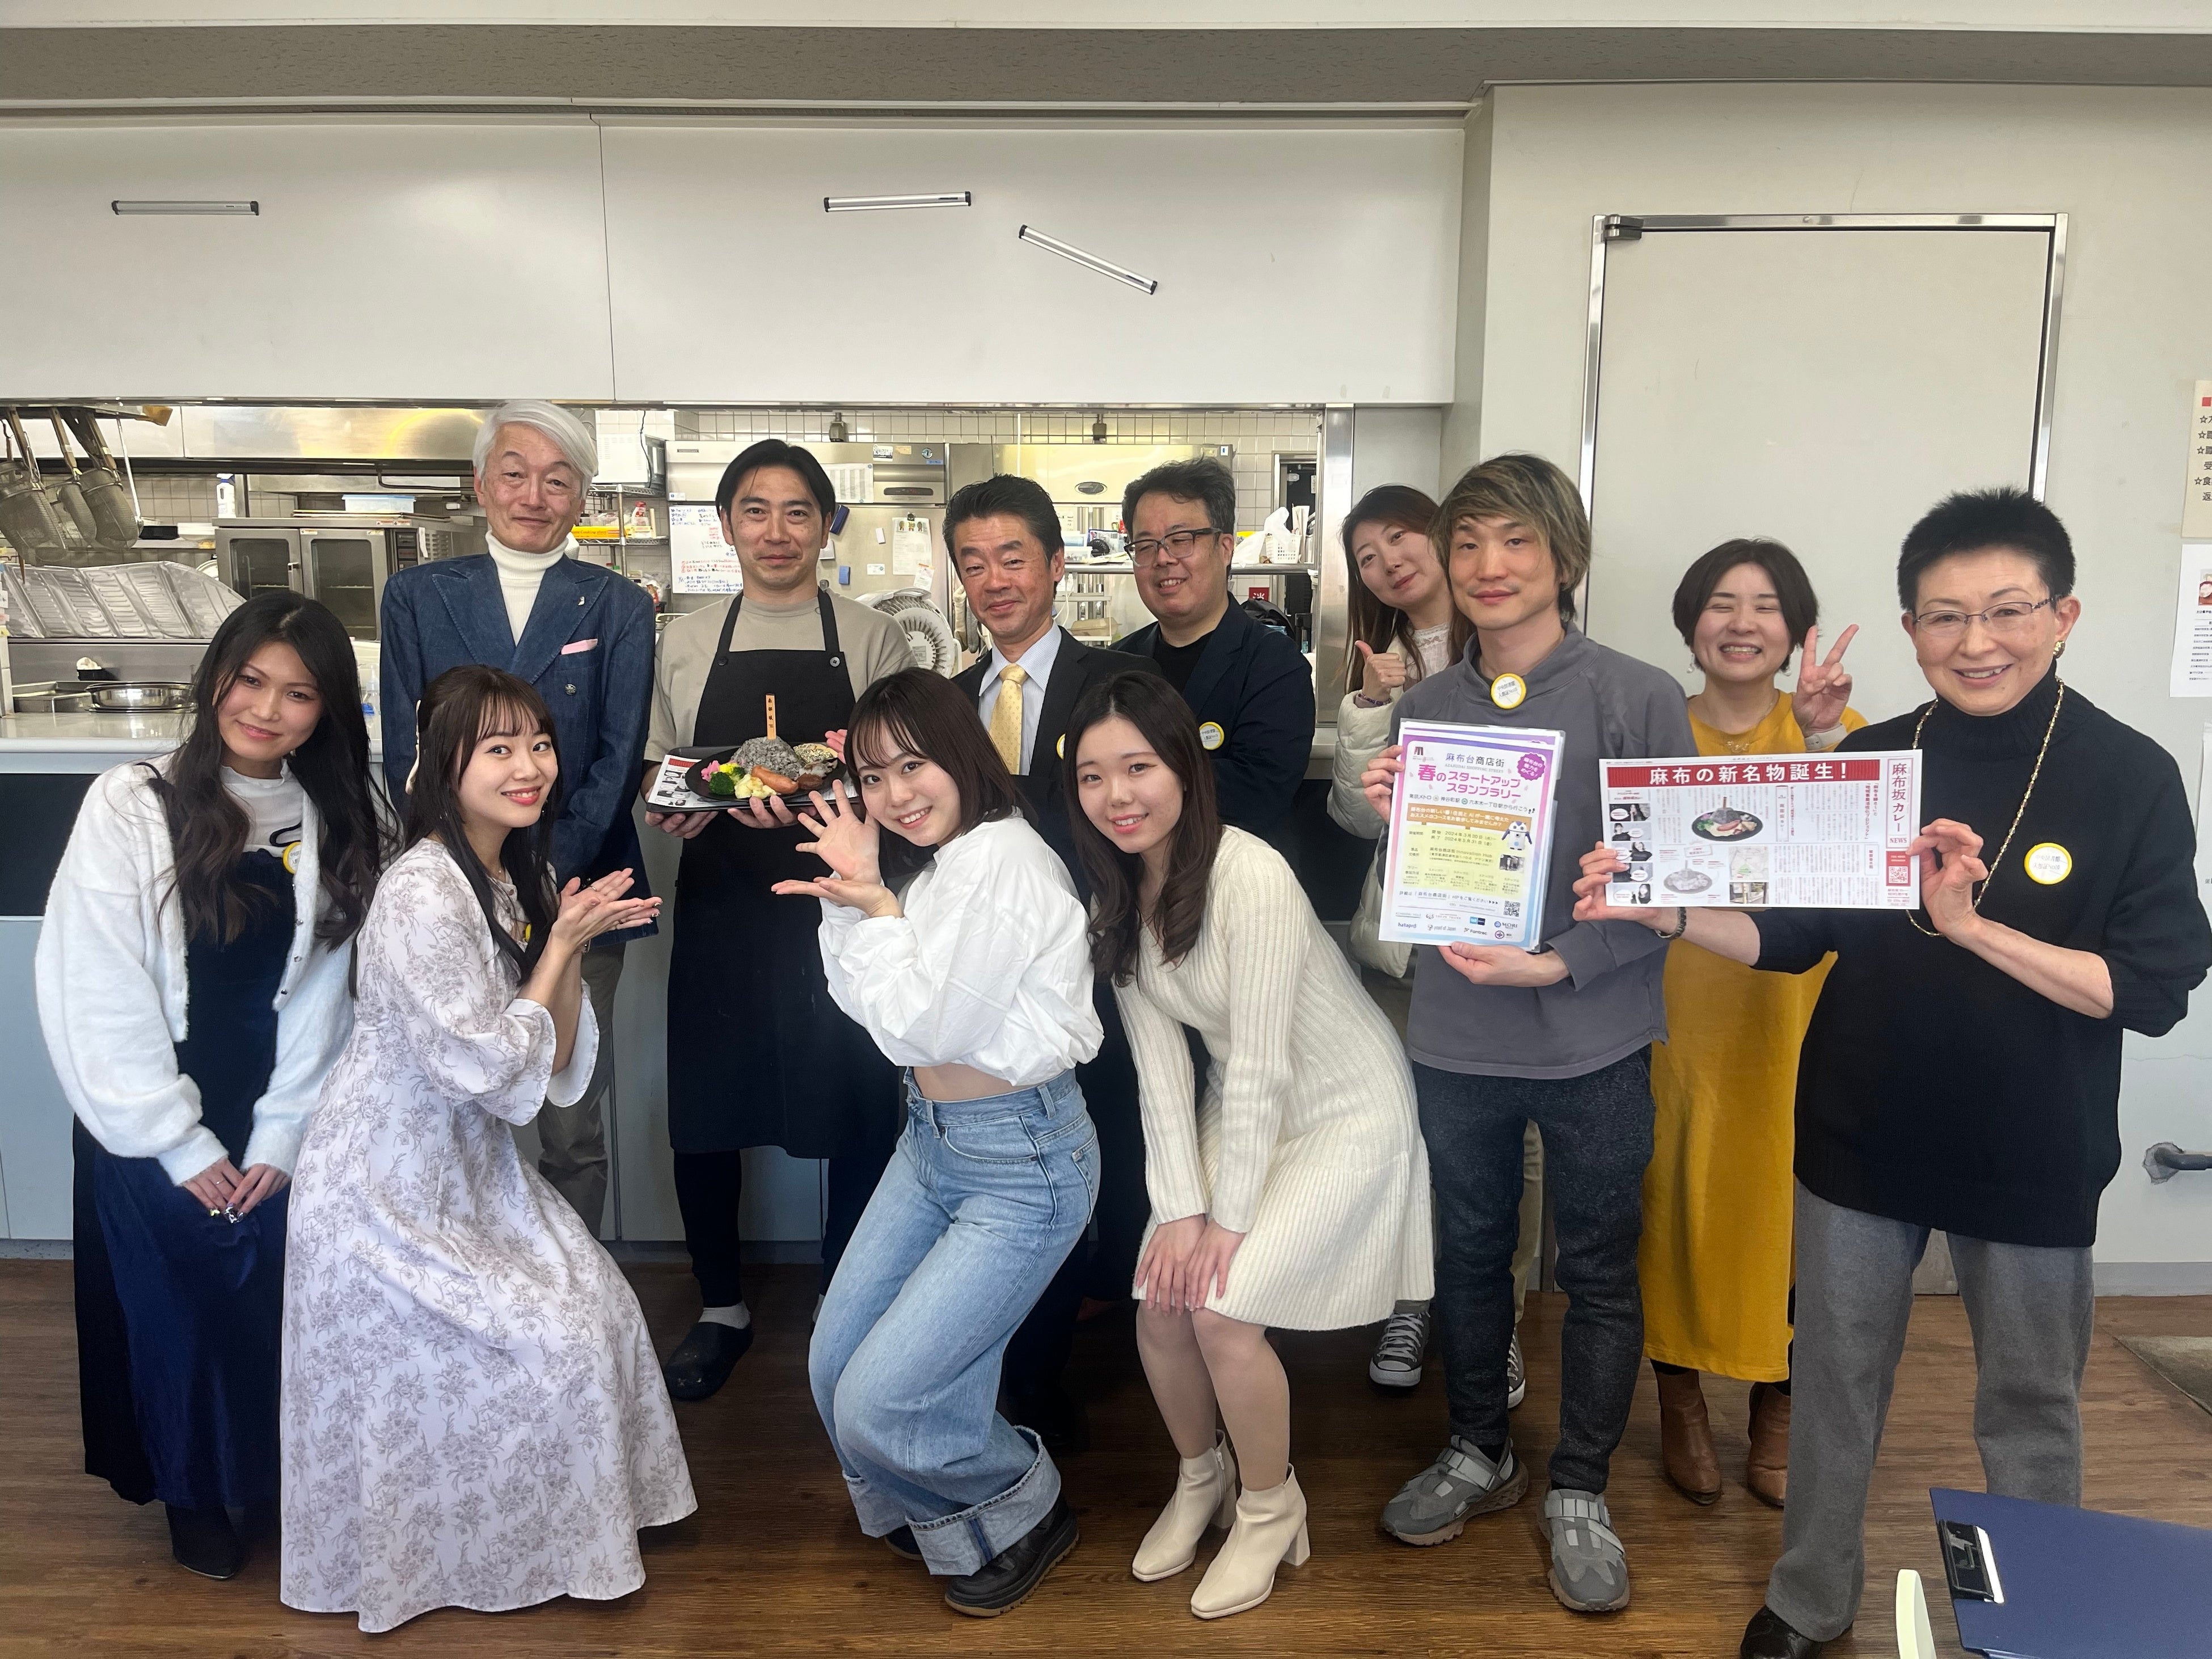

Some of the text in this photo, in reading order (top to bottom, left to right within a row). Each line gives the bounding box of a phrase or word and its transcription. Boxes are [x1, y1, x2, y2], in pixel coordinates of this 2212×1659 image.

[1445, 753, 1505, 767] 麻布台商店街
[1649, 762, 1847, 785] 麻布の新名物誕生！
[1447, 783, 1521, 799] スタンプラリー
[1892, 763, 1907, 833] 麻布坂カレー
